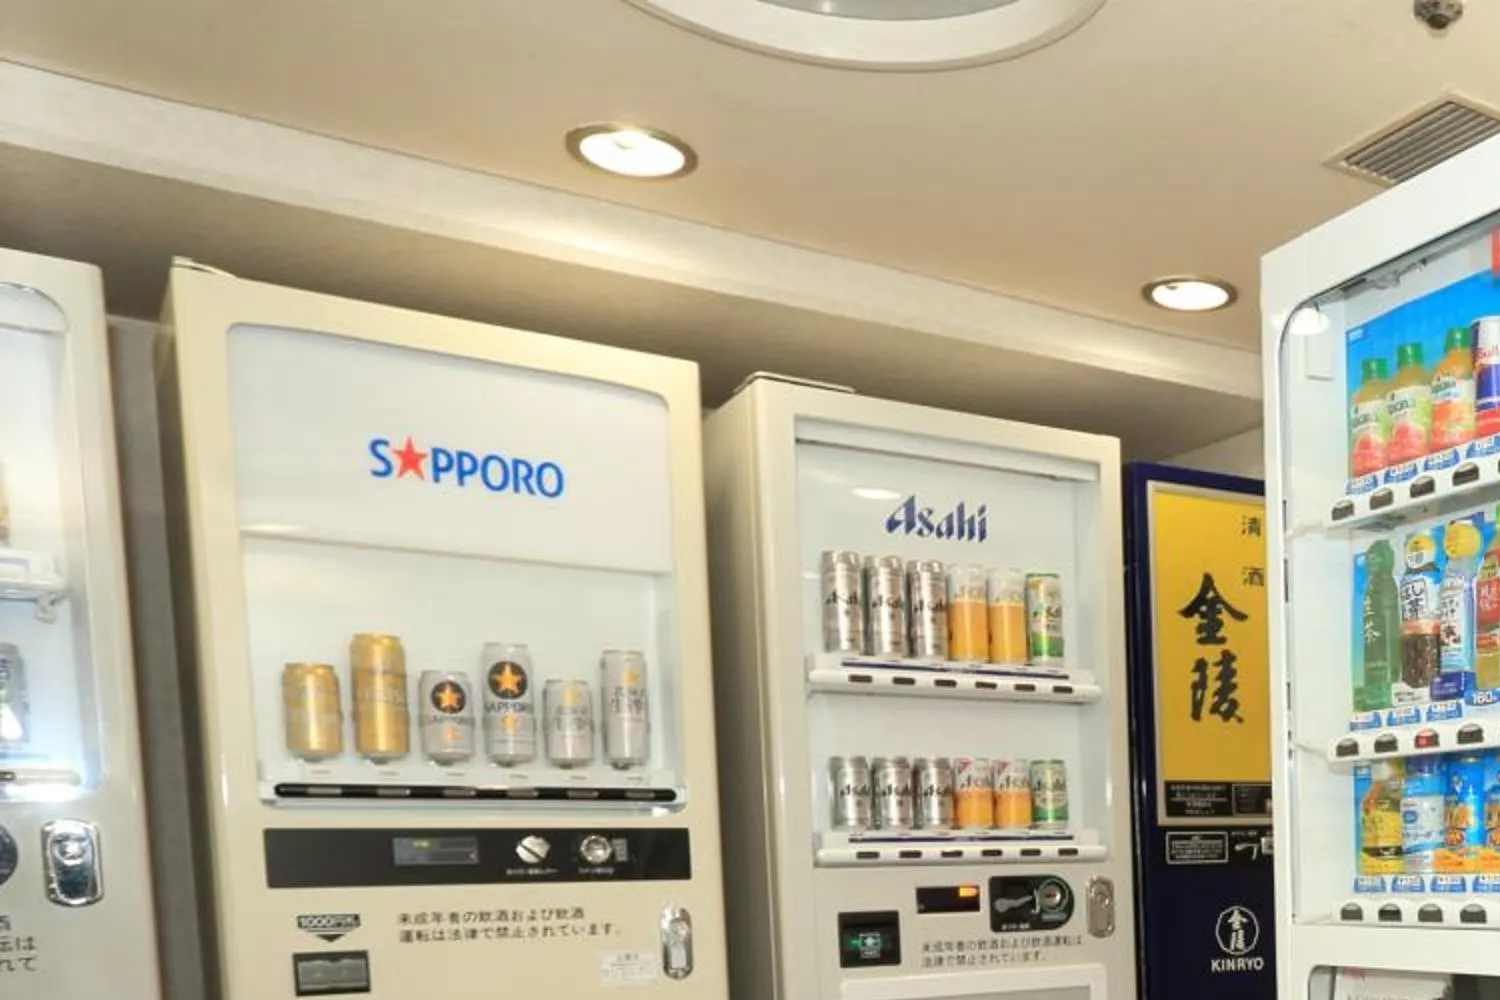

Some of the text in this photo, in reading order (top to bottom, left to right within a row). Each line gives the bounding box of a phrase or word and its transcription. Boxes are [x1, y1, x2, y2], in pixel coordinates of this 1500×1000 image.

[886, 495, 988, 543] Asahi
[1241, 514, 1265, 588] 清酒
[1177, 572, 1249, 725] 金陵
[399, 906, 585, 926] 未成年者の飲酒および飲酒
[1211, 957, 1265, 973] KINRYO
